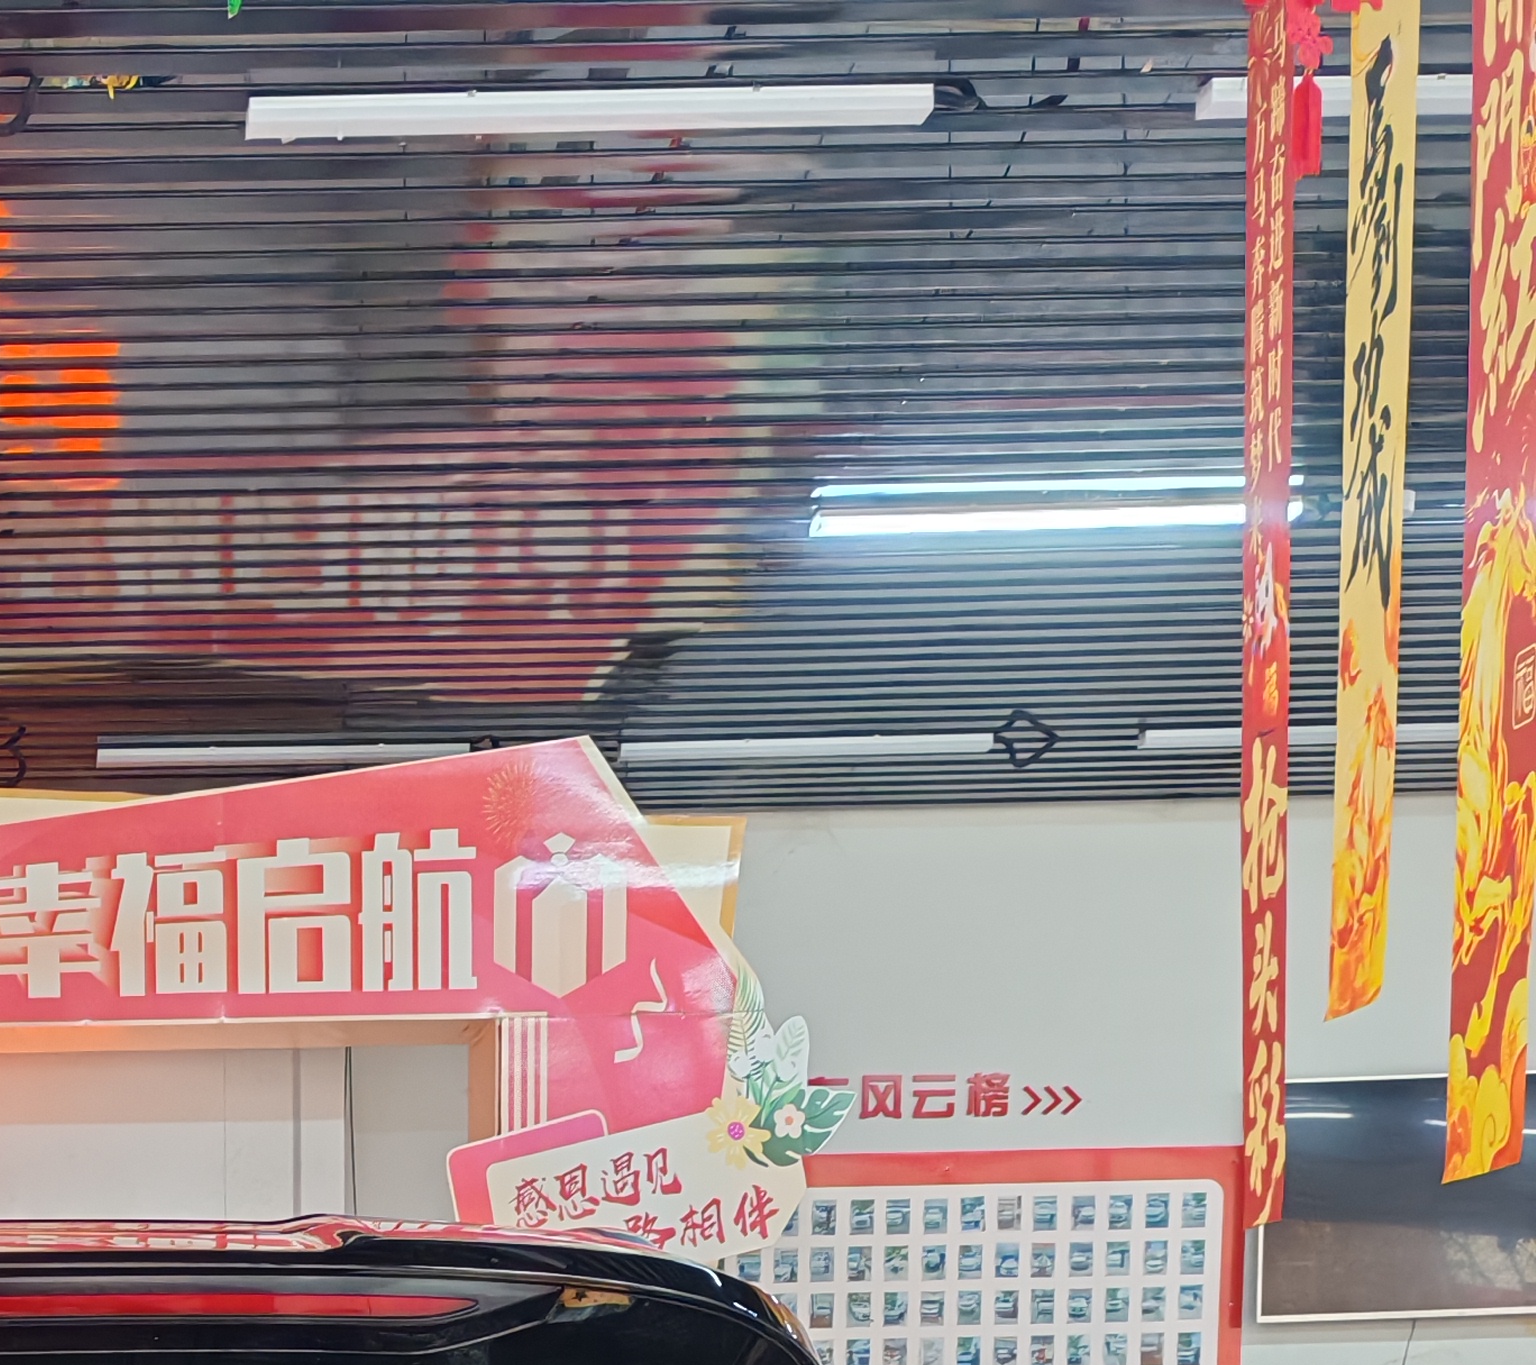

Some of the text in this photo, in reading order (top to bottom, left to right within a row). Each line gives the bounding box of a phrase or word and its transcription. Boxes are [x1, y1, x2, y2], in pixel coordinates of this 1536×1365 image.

[1242, 737, 1288, 1227] 抢头彩
[808, 1072, 1011, 1119] 风云榜
[509, 1147, 682, 1229] 感恩遇见
[624, 1184, 780, 1250] 路相伴
